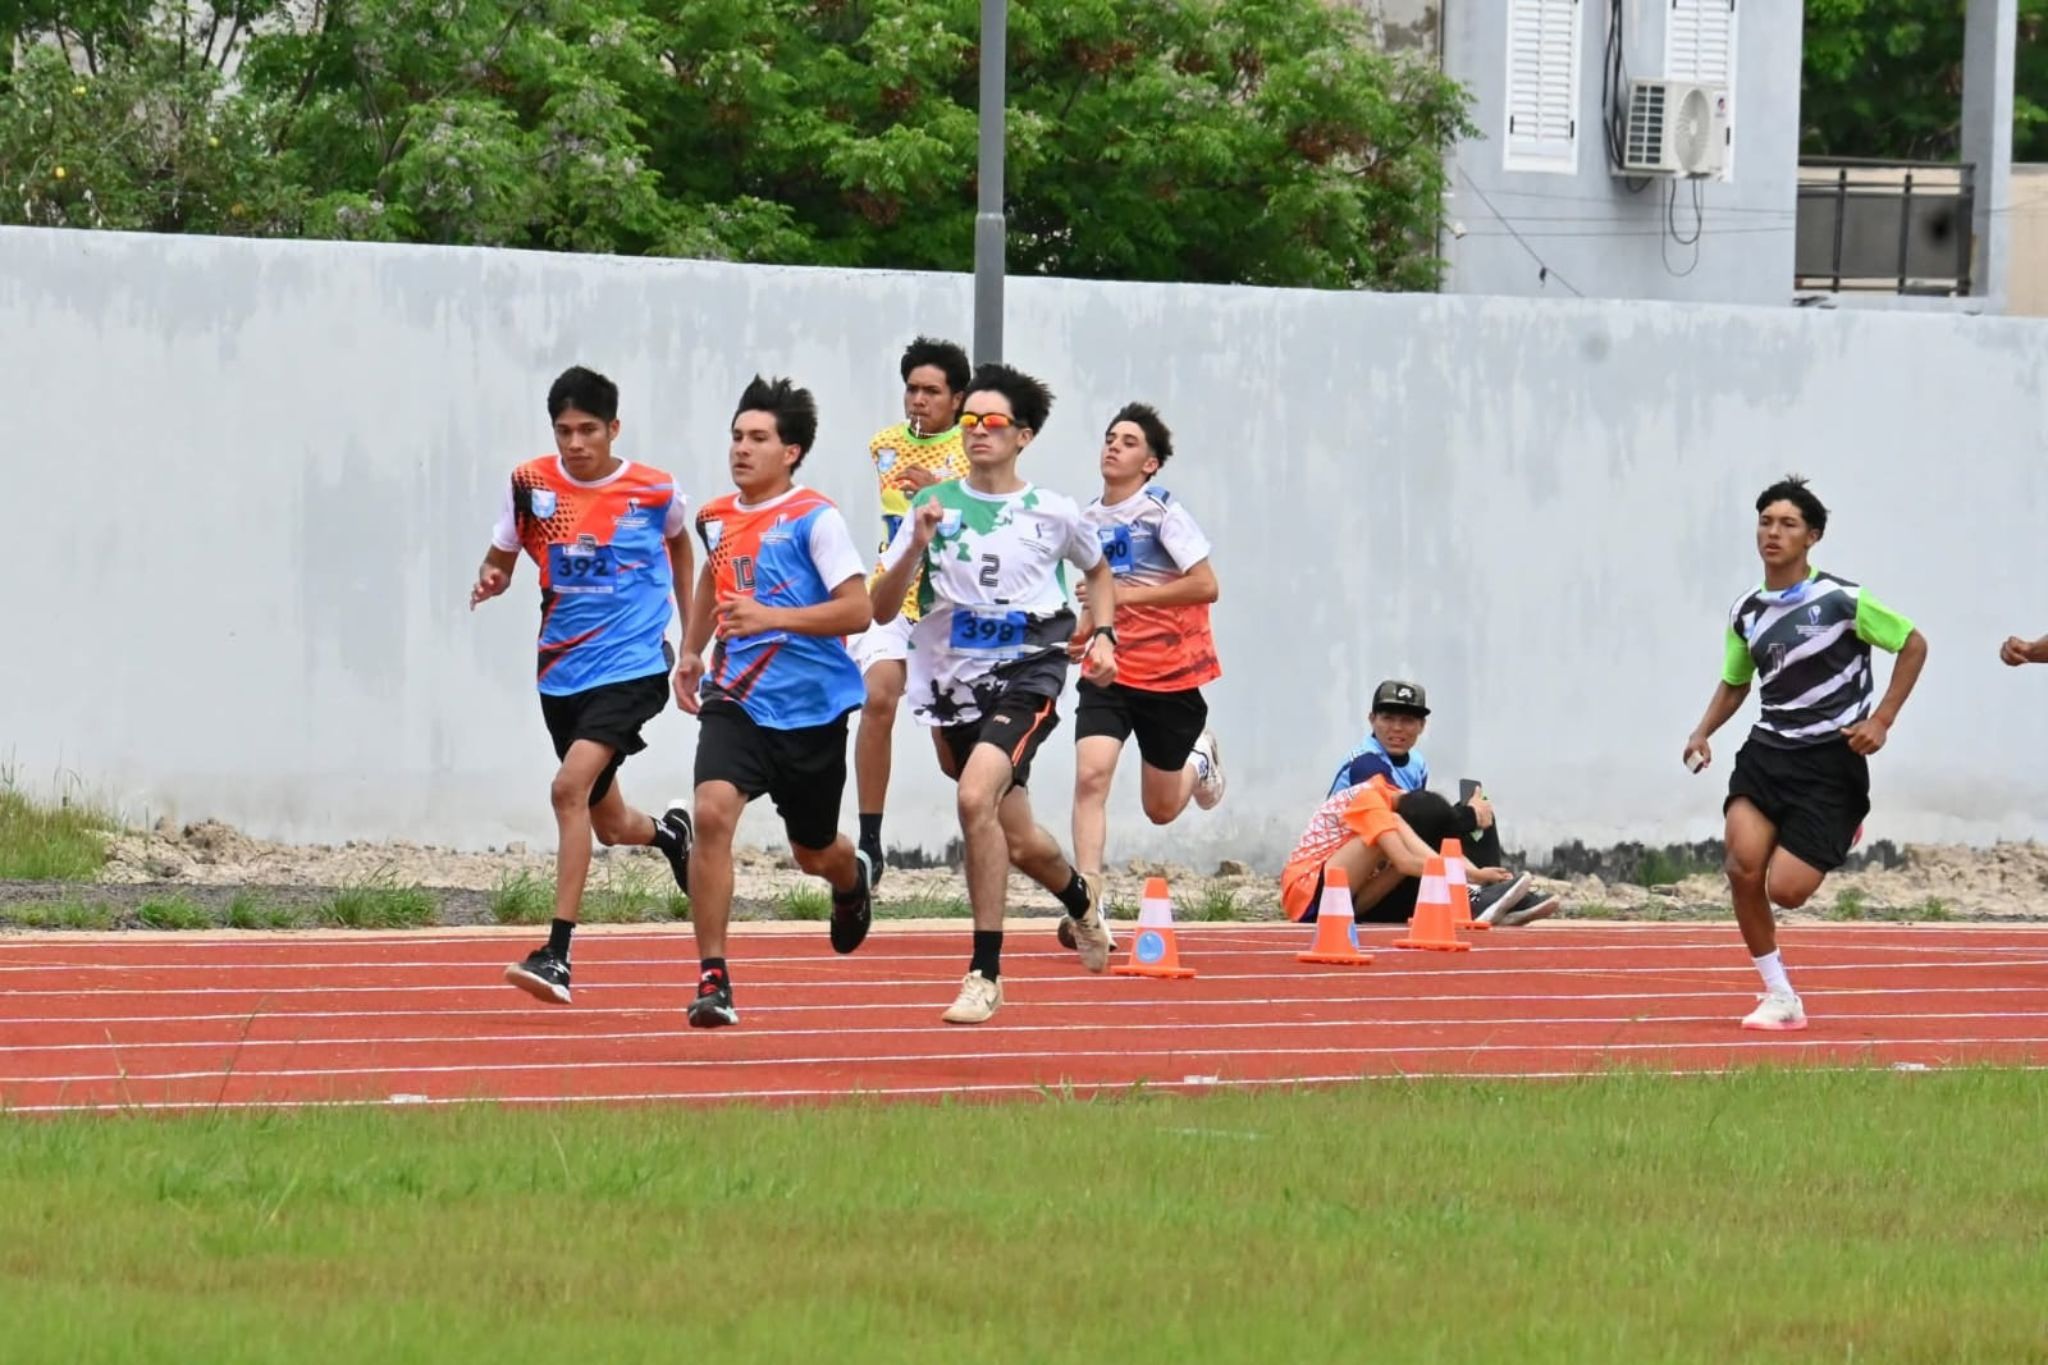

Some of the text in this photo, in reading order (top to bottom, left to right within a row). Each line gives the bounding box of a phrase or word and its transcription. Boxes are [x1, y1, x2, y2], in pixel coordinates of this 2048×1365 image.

[1103, 540, 1128, 561] 90
[558, 557, 609, 577] 392
[979, 553, 1000, 587] 2
[961, 618, 1015, 642] 398
